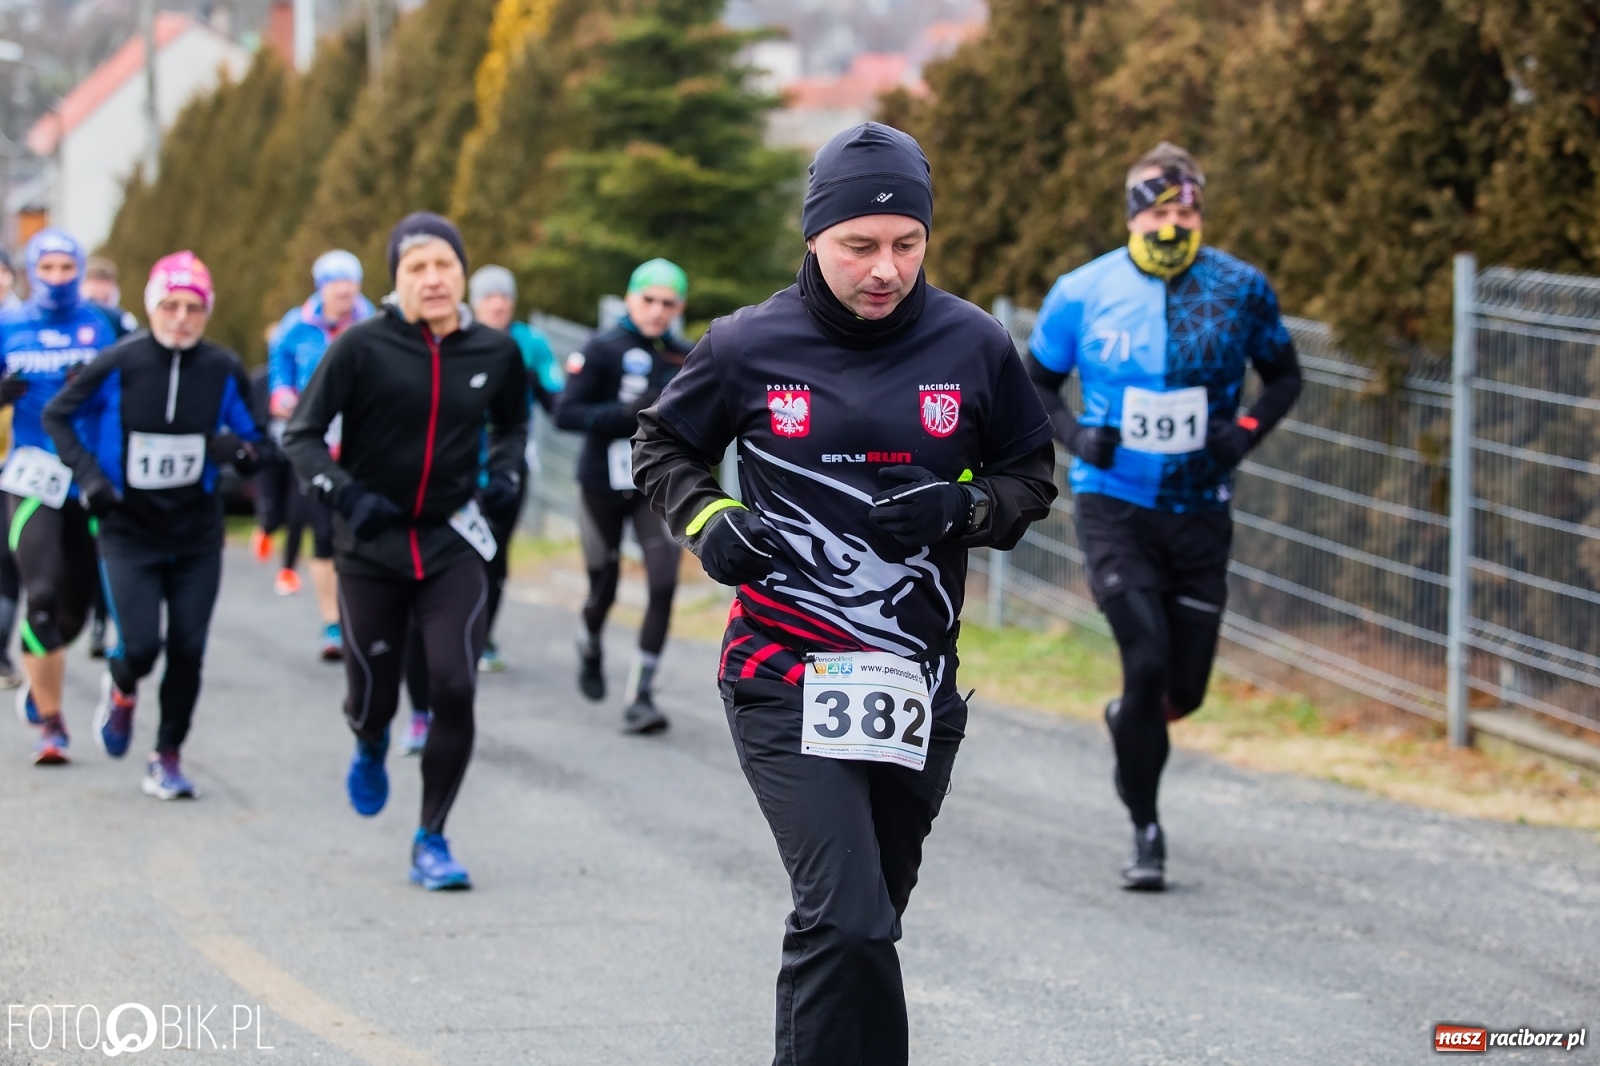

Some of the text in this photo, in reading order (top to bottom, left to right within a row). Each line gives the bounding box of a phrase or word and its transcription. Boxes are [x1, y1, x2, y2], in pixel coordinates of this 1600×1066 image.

[1097, 330, 1131, 362] 71
[766, 384, 810, 392] POLSKA
[919, 382, 961, 391] RACIBÓRZ
[1131, 413, 1198, 441] 391
[139, 454, 196, 478] 187
[813, 690, 926, 748] 382
